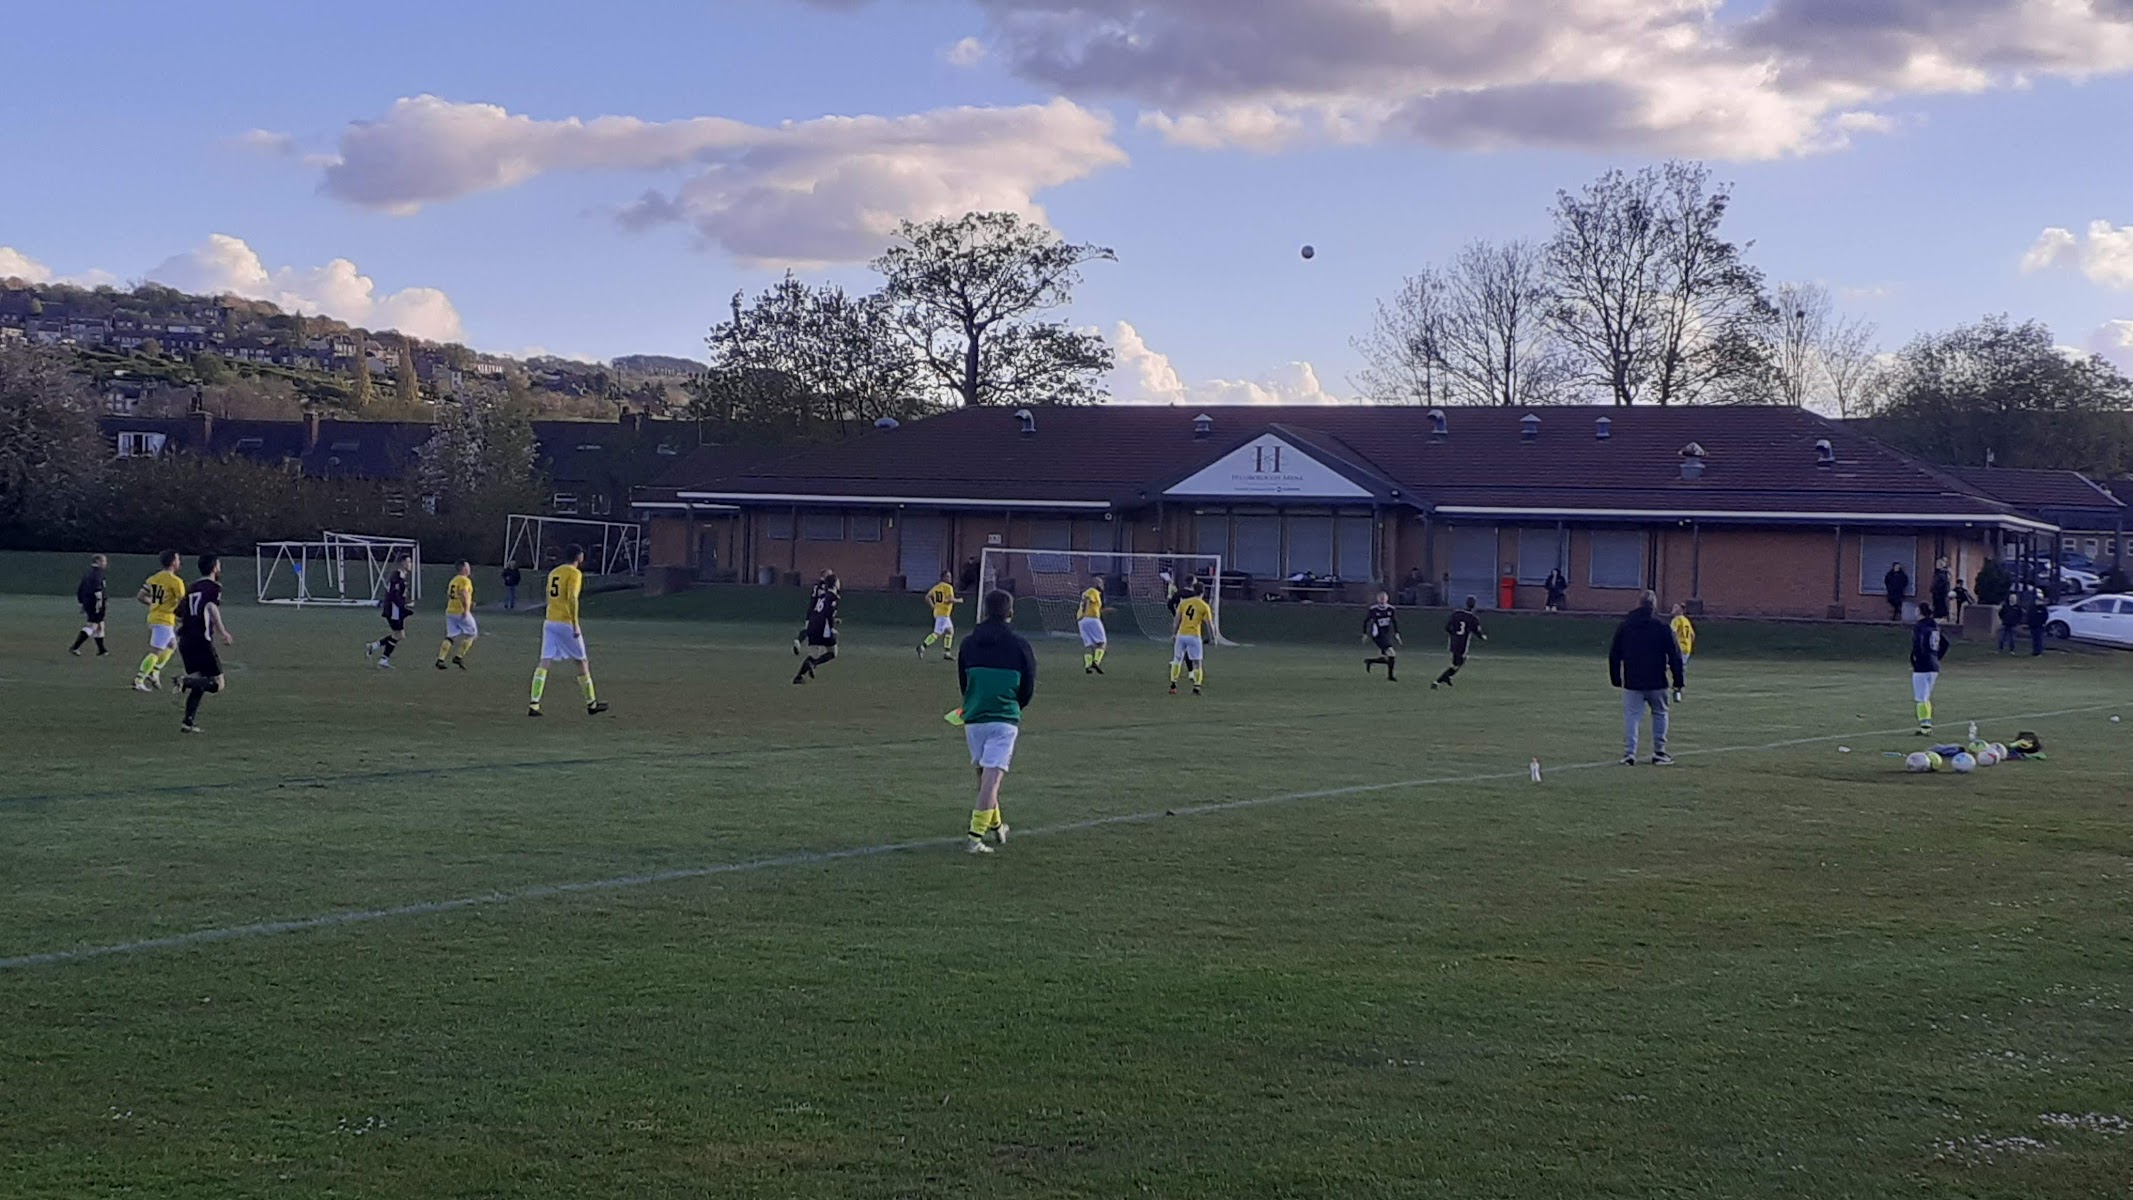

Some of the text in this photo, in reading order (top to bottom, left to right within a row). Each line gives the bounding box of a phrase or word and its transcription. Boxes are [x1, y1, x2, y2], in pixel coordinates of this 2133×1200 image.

[151, 584, 165, 605] 14
[550, 576, 560, 598] 5
[188, 592, 202, 616] 17
[935, 590, 943, 604] 10
[1185, 604, 1195, 621] 4
[1455, 620, 1466, 636] 3
